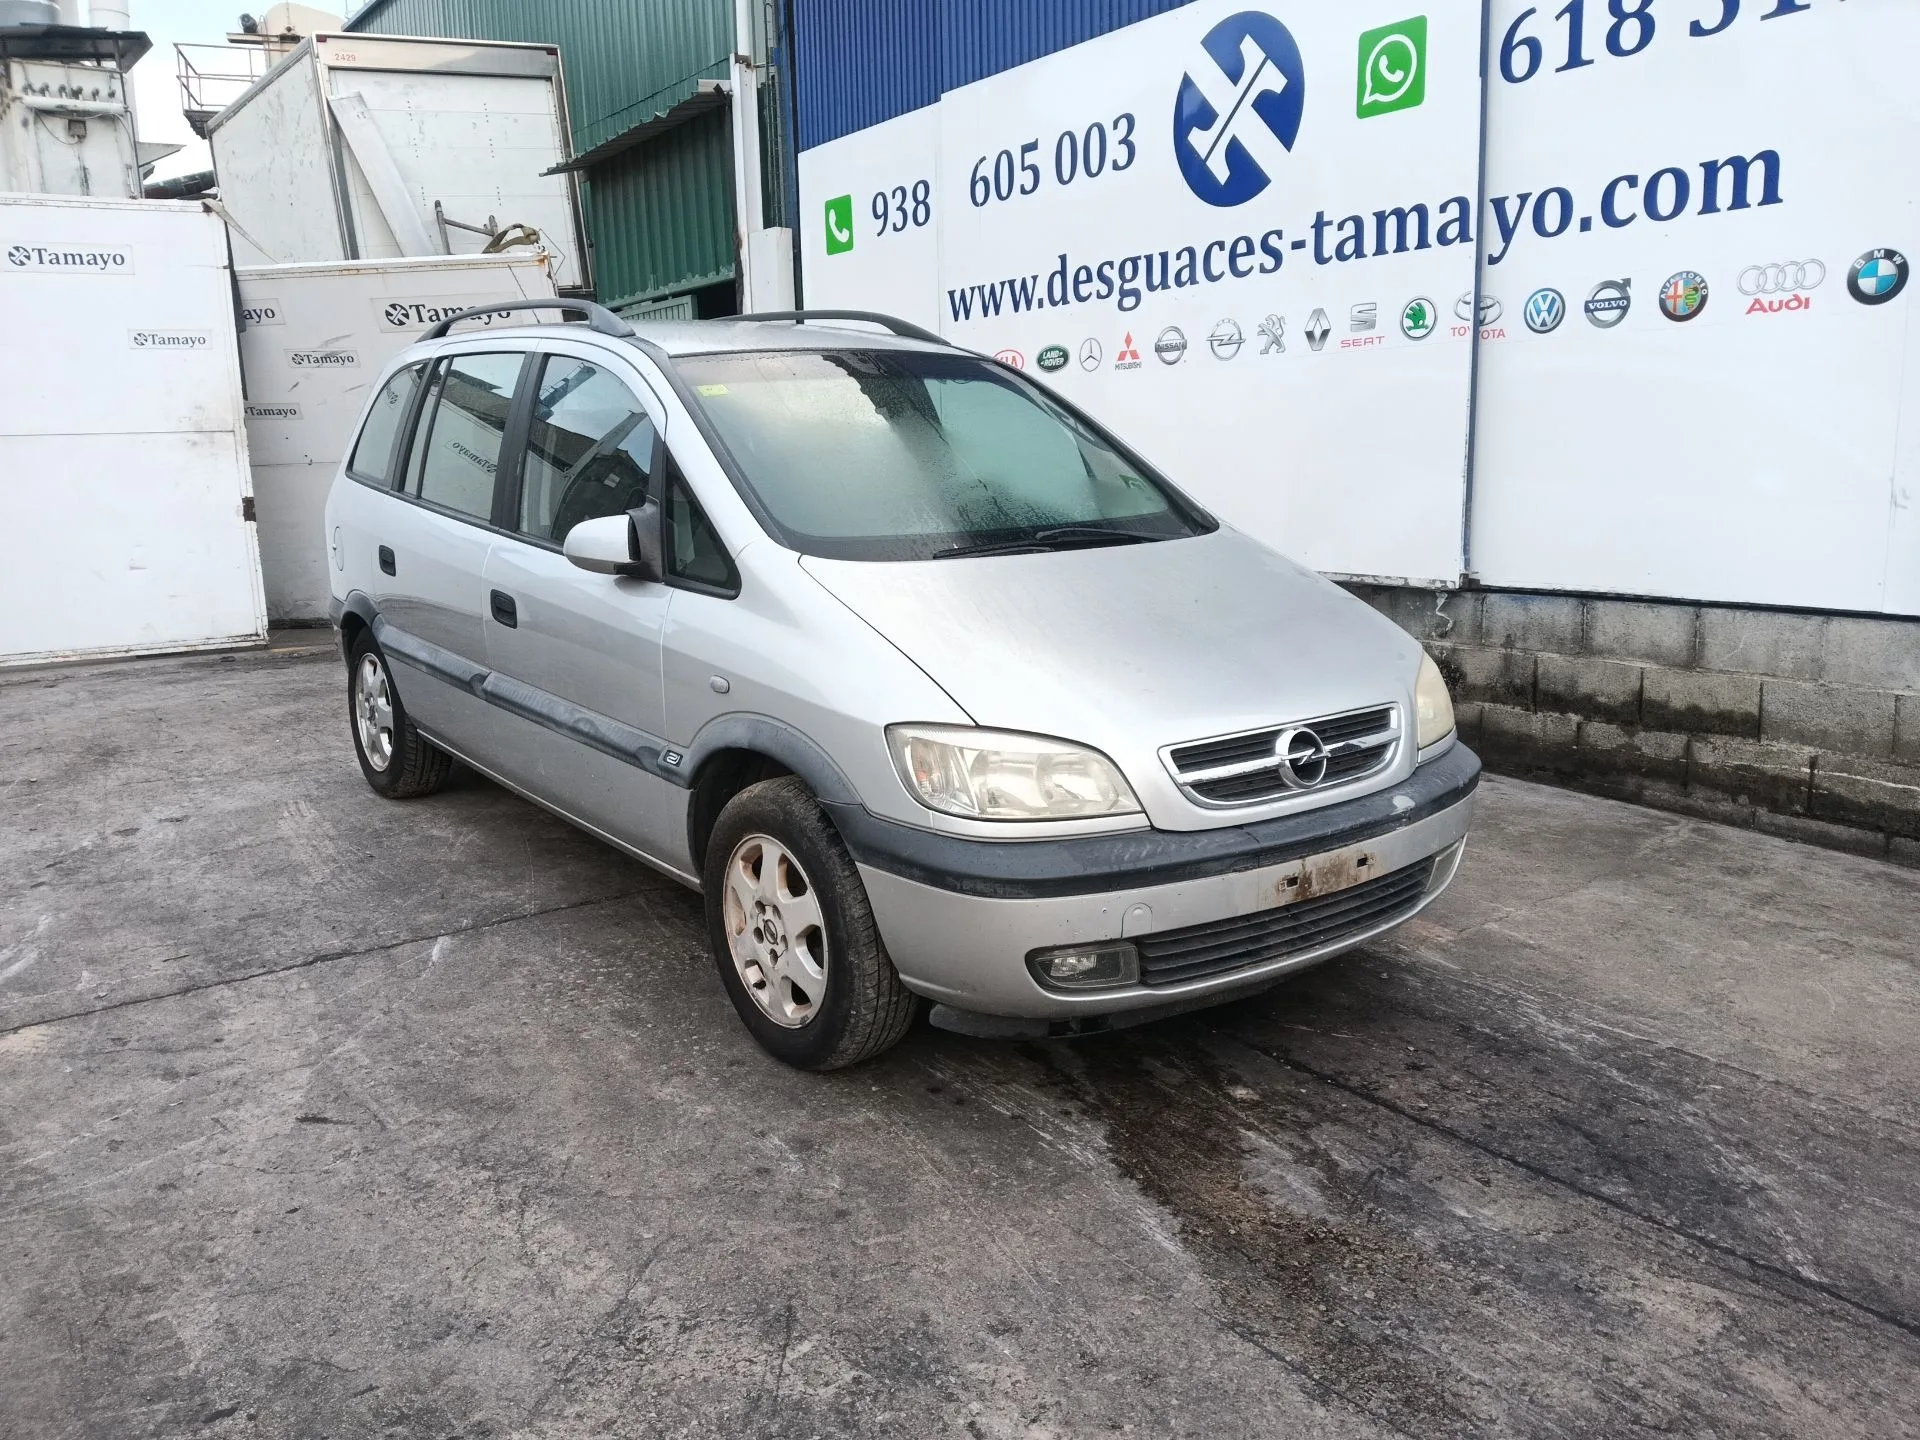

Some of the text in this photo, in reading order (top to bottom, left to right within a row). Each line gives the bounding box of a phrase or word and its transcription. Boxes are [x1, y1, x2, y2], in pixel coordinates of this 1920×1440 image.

[1499, 0, 1656, 84] 618
[872, 112, 1136, 237] 938 605 003
[947, 149, 1783, 322] www.desguaces-tamayo.com
[31, 247, 126, 271] Tamayo
[1587, 299, 1628, 310] VOLVO
[1745, 293, 1811, 315] Audi
[242, 307, 276, 324] ayo
[147, 333, 206, 348] Tamayo
[1450, 326, 1506, 341] TOOTA
[1156, 340, 1186, 351] NISSAN
[1340, 335, 1385, 348] SEAT
[303, 353, 355, 366] Tamayo
[1043, 350, 1060, 359] LAND
[1044, 358, 1065, 367] ROVER
[249, 406, 297, 418] Tamayo
